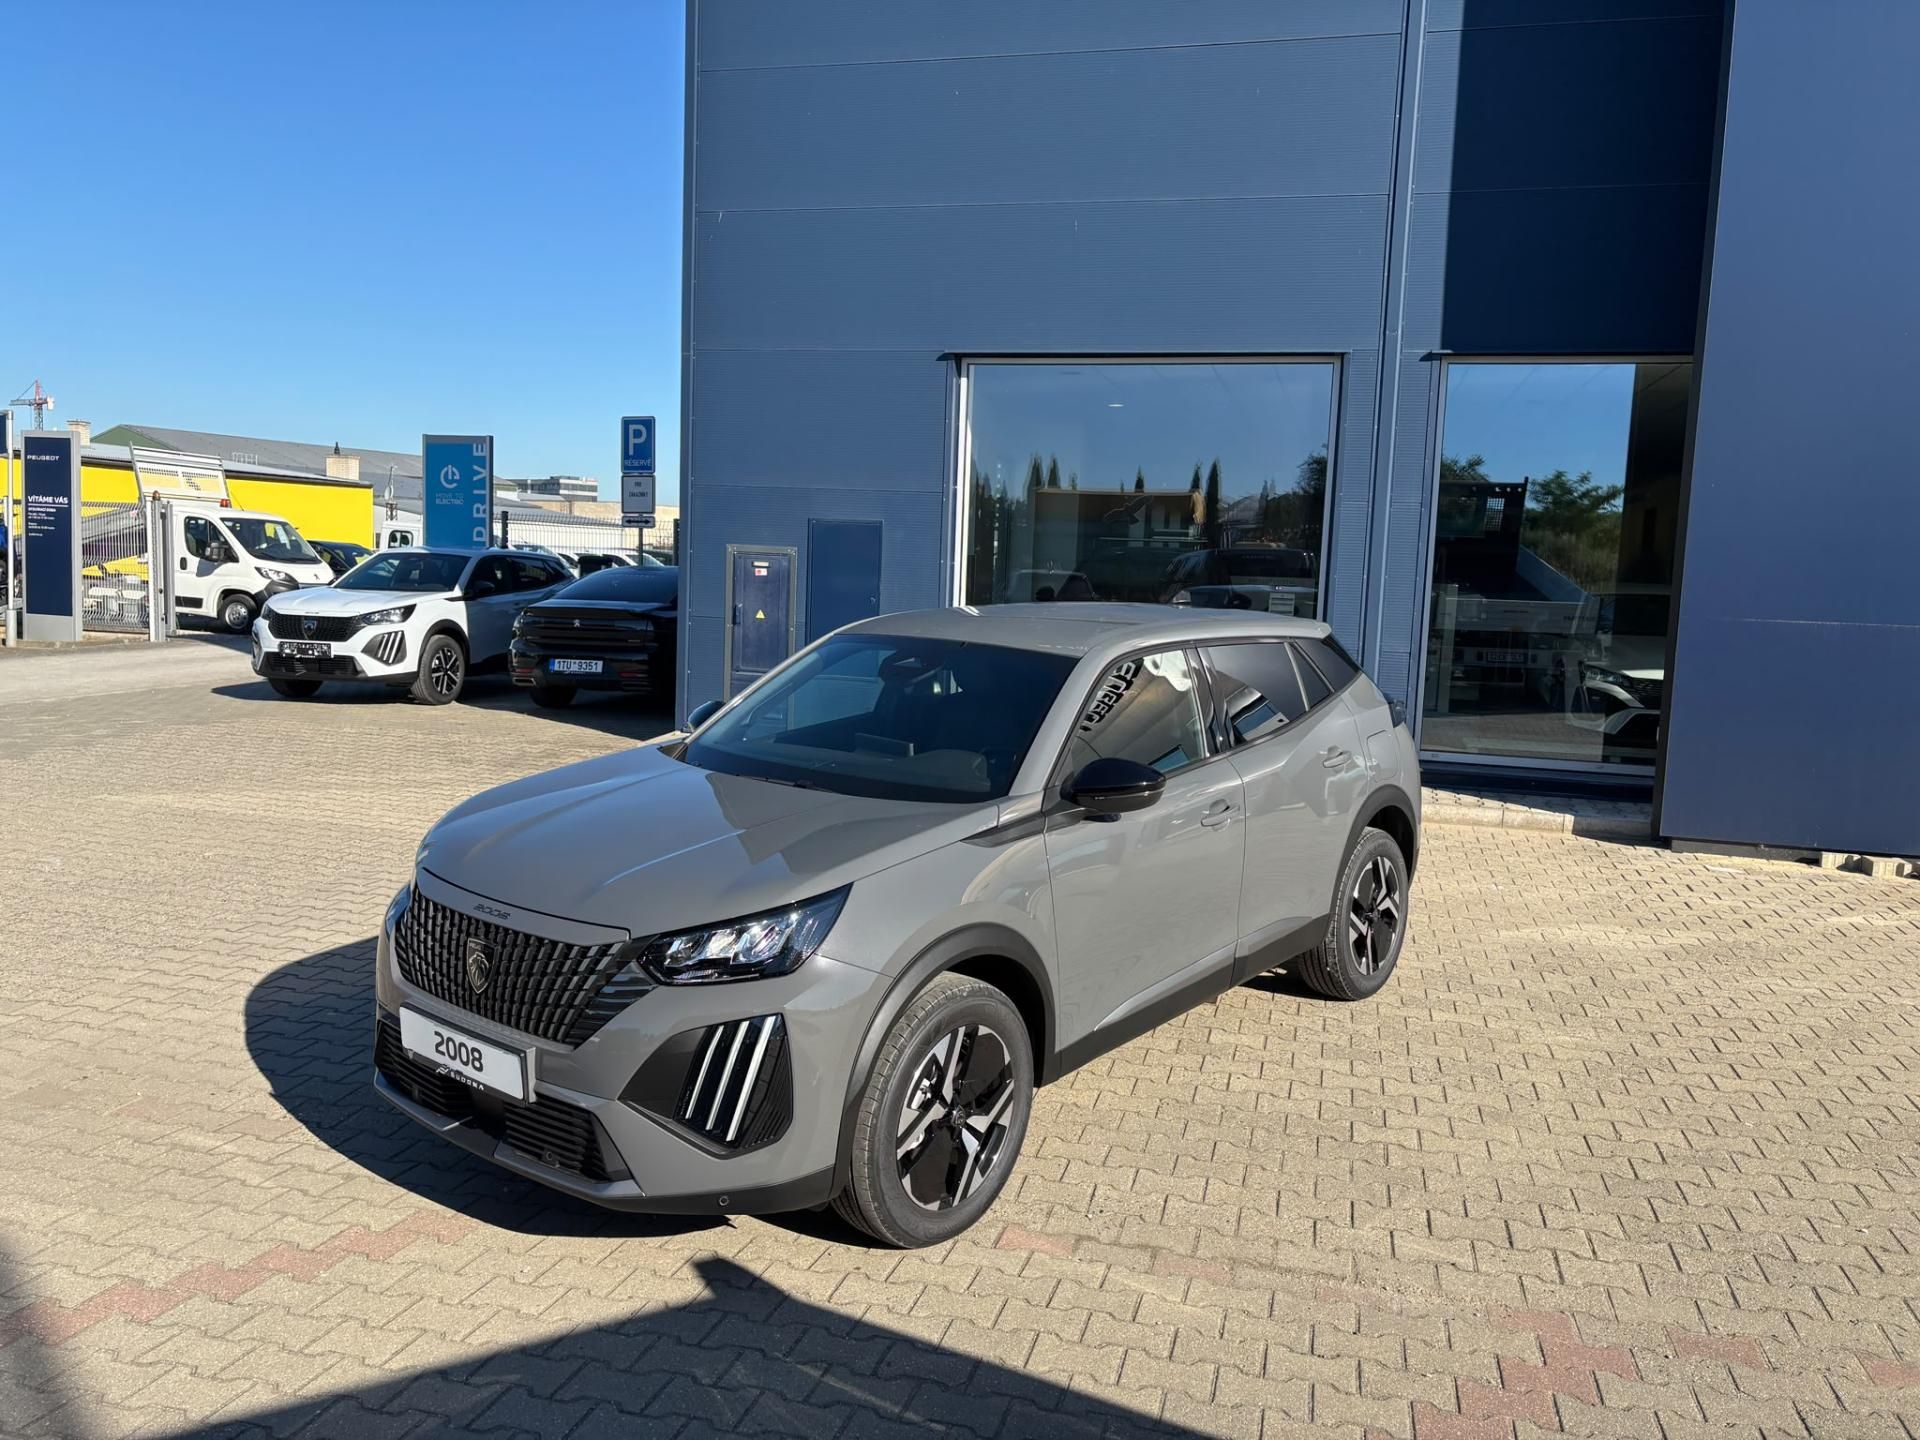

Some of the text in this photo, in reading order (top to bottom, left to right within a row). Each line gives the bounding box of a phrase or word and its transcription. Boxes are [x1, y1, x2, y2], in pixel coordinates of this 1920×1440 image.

[628, 424, 647, 456] P
[473, 443, 486, 541] DRIVE
[434, 1030, 484, 1073] 2008
